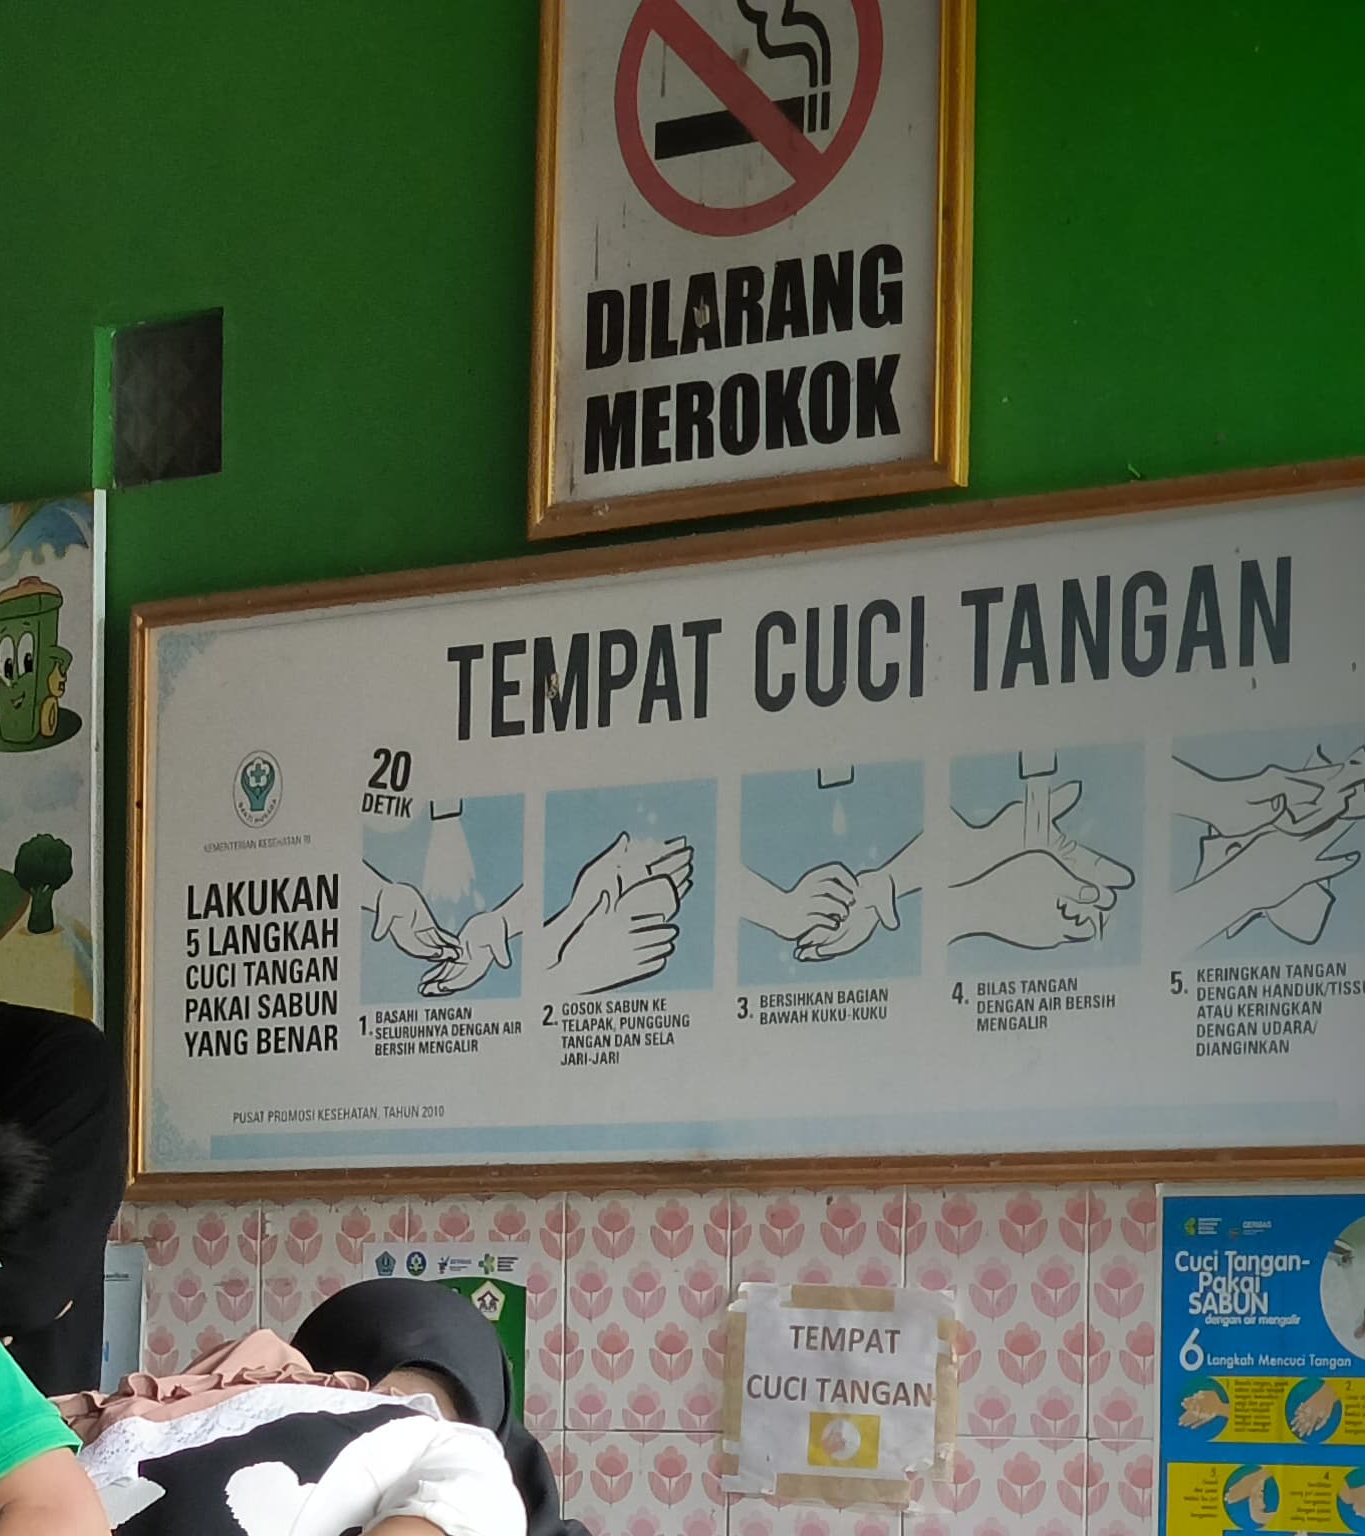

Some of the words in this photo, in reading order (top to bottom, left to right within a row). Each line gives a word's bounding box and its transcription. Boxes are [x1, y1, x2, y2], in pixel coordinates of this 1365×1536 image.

[585, 243, 903, 371] DILARANG
[584, 353, 901, 475] MEROKOK
[447, 618, 722, 740] TEMPAT
[754, 595, 925, 713] CUCI
[961, 556, 1292, 692] TANGAN
[368, 748, 413, 792] 20
[361, 793, 414, 818] DETIK
[187, 873, 339, 920] LAKUKAN
[186, 929, 200, 957] 5
[208, 917, 339, 957] LANGKAH
[186, 962, 236, 990] CUCI
[243, 955, 338, 987] TANGAN
[1170, 971, 1188, 995] 5.
[1197, 965, 1281, 983] KERINGKAN
[1285, 962, 1347, 978] TANGAN
[951, 981, 969, 1005] 4.
[977, 981, 1016, 996] BILAS
[1020, 977, 1078, 994] TANGAN
[1197, 984, 1258, 1001] DENGAN
[185, 995, 250, 1023] PAKAI
[257, 990, 338, 1019] SABUN
[562, 1001, 603, 1017] GOSOK
[605, 999, 649, 1014] SABUN
[652, 998, 667, 1012] KE
[737, 997, 753, 1020] 3.
[760, 992, 833, 1009] BERSIHKAN
[837, 988, 889, 1004] BAGIAN
[976, 998, 1034, 1014] DENGAN
[1038, 996, 1062, 1012] AIR
[1065, 994, 1116, 1010] BERSIH
[1197, 1004, 1233, 1019] ATAU
[1237, 1000, 1322, 1017] KERINGKAN
[359, 1015, 373, 1036] 1.
[375, 1009, 418, 1023] BASAHI
[424, 1007, 472, 1022] TANGAN
[542, 1004, 558, 1027] 2.
[620, 1014, 691, 1030] PUNGGUNG
[760, 1009, 808, 1025] BAWAH
[811, 1006, 888, 1023] KUKU-KUKU
[976, 1015, 1048, 1032] MENGALIR
[375, 1024, 449, 1040] SELURUHNYA
[451, 1021, 500, 1037] DENGAN
[502, 1021, 522, 1035] AIR
[561, 1034, 611, 1049] TANGAN
[614, 1033, 641, 1047] DAN
[644, 1031, 675, 1046] SELA
[1196, 1022, 1258, 1038] DENGAN
[1262, 1019, 1318, 1036] UDARA/
[184, 1028, 248, 1058] YANG
[256, 1024, 339, 1055] BENAR
[374, 1042, 416, 1056] BERSIH
[418, 1039, 479, 1053] MENGALIR
[1196, 1040, 1290, 1057] DIANGINKAN
[560, 1051, 620, 1066] JARI-JARI
[233, 1110, 264, 1124] PUSAT
[268, 1108, 315, 1122] PROMOSI
[383, 1105, 419, 1119] TAHUN
[422, 1105, 445, 1118] 2010
[1175, 1250, 1219, 1273] Cuci
[1199, 1271, 1261, 1295] Pakai
[1188, 1292, 1269, 1315] SABUN
[789, 1325, 901, 1354] TEMPAT
[1179, 1327, 1204, 1372] 6
[1207, 1354, 1254, 1370] Langkah
[1259, 1353, 1305, 1368] Mencuci
[1310, 1354, 1351, 1371] Tangan
[746, 1375, 807, 1402] CUCI
[816, 1378, 932, 1407] TANGAN
